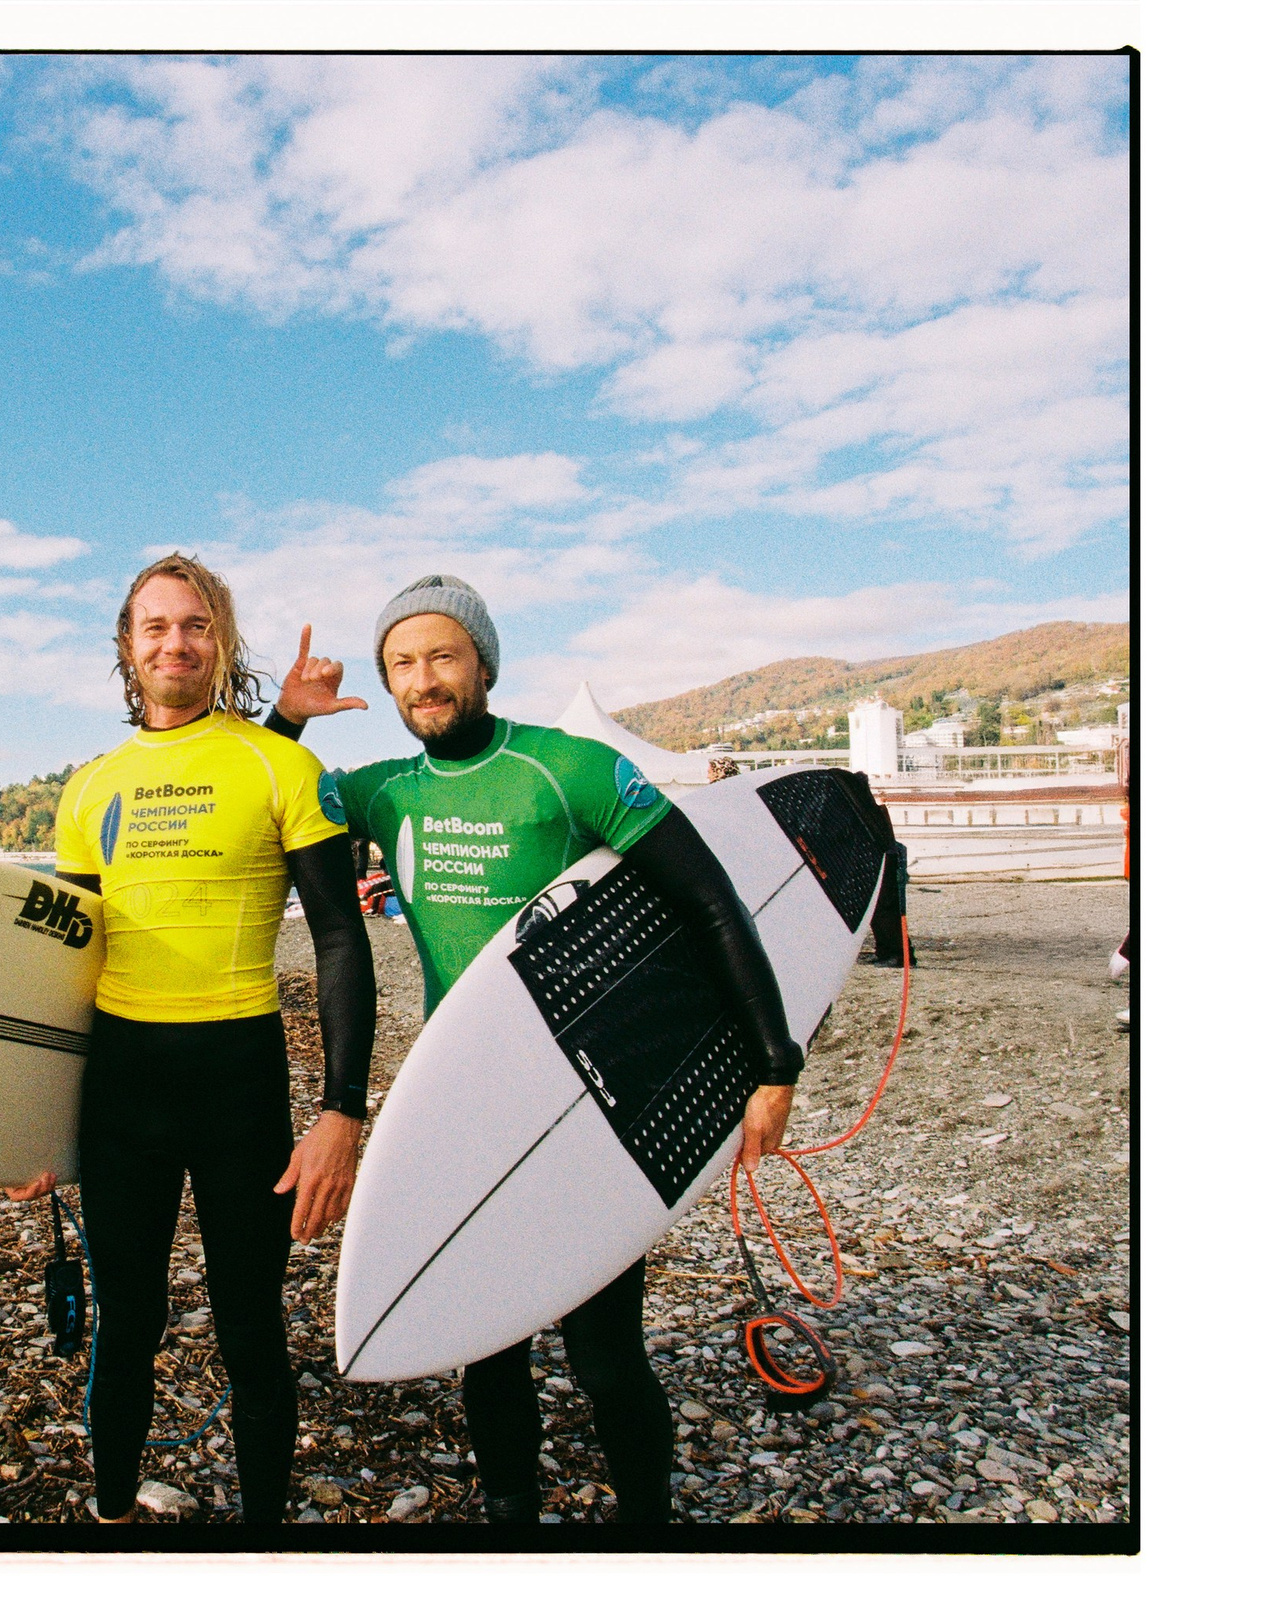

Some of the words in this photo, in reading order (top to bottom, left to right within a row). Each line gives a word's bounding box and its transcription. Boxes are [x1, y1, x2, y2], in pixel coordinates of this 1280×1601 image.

[134, 784, 214, 801] BetBoom
[131, 803, 216, 819] ЧЕМПИОНАТ
[128, 820, 187, 832] РОССИИ
[423, 817, 504, 835] BetBoom
[126, 840, 139, 849] ПО
[140, 838, 189, 849] СЕРФИНГУ
[422, 842, 510, 858] ЧЕМПИОНАТ
[125, 850, 180, 859] «КОРОТКАЯ
[181, 849, 224, 859] ДОСКА»
[423, 860, 484, 876] РОССИИ
[424, 882, 438, 891] ПО
[440, 883, 490, 894] СЕРФИНГУ
[426, 895, 482, 906] «КОРОТКАЯ
[483, 896, 528, 907] ДОСКА»
[575, 1049, 617, 1108] FCS
[65, 1295, 76, 1333] FCS
